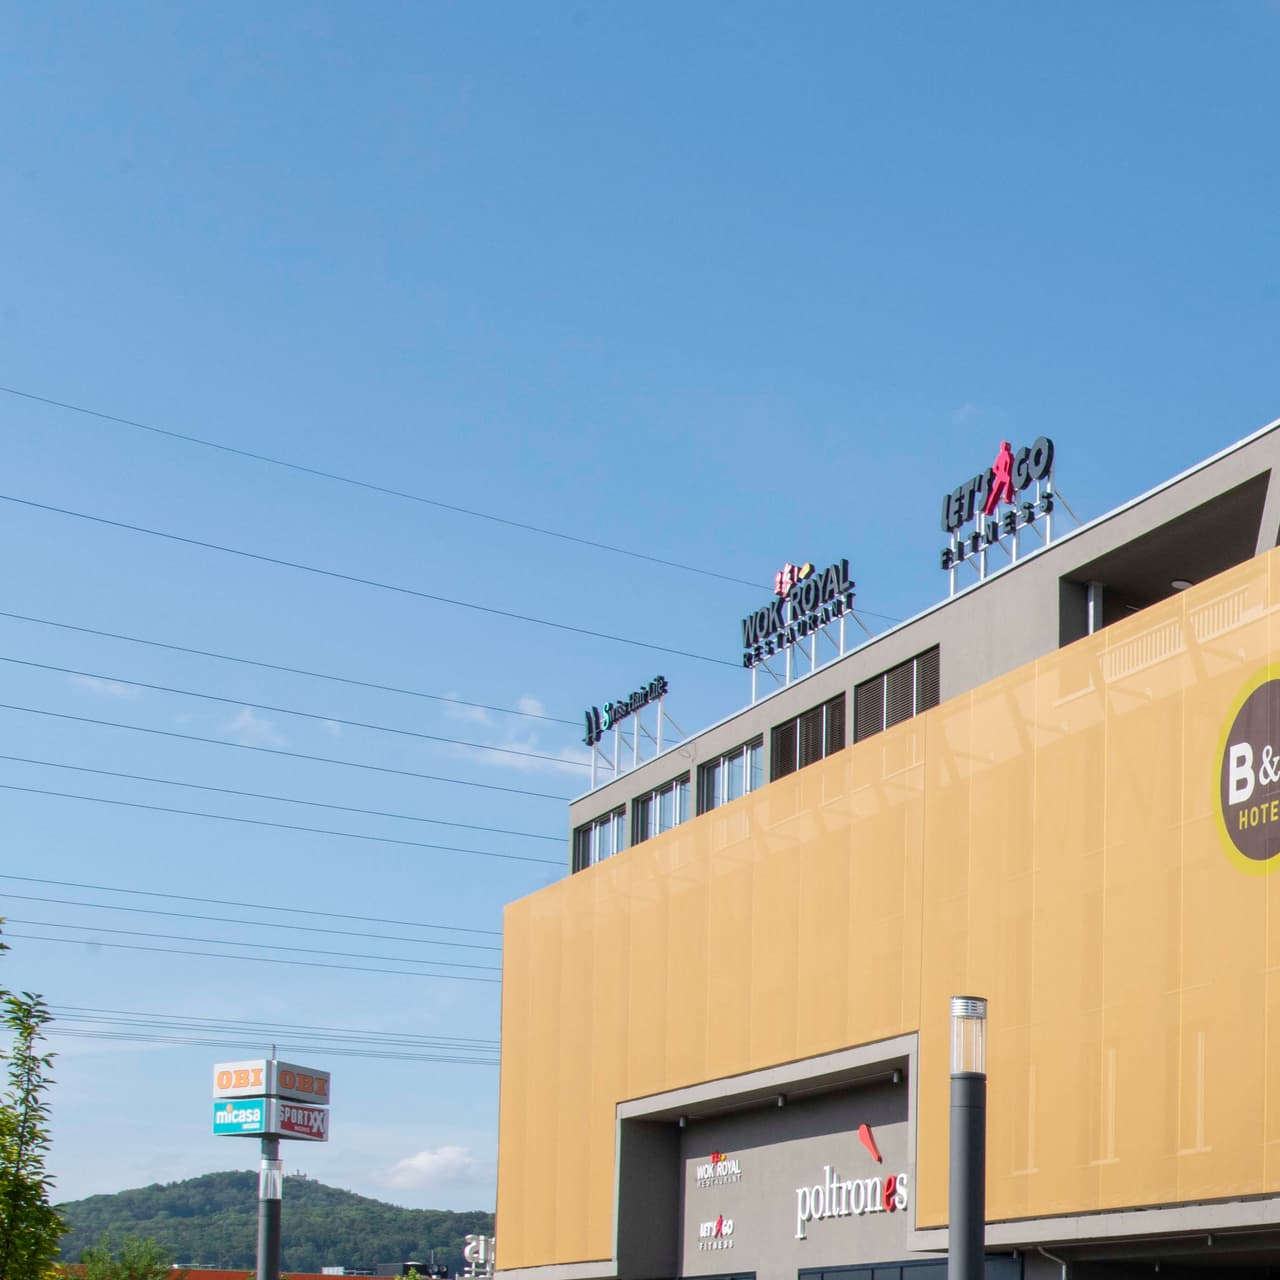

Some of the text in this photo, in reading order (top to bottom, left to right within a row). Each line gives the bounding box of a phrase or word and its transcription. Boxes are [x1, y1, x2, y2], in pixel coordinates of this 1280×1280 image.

[942, 435, 1054, 533] LET'S GO
[942, 491, 1053, 570] FITNESS
[743, 558, 855, 649] WOK ROYAL
[743, 592, 856, 669] RESTAURANT
[216, 1068, 264, 1090] OBI
[279, 1070, 329, 1097] OBI
[215, 1103, 261, 1125] micasa
[696, 1159, 742, 1181] WOK ROYAL
